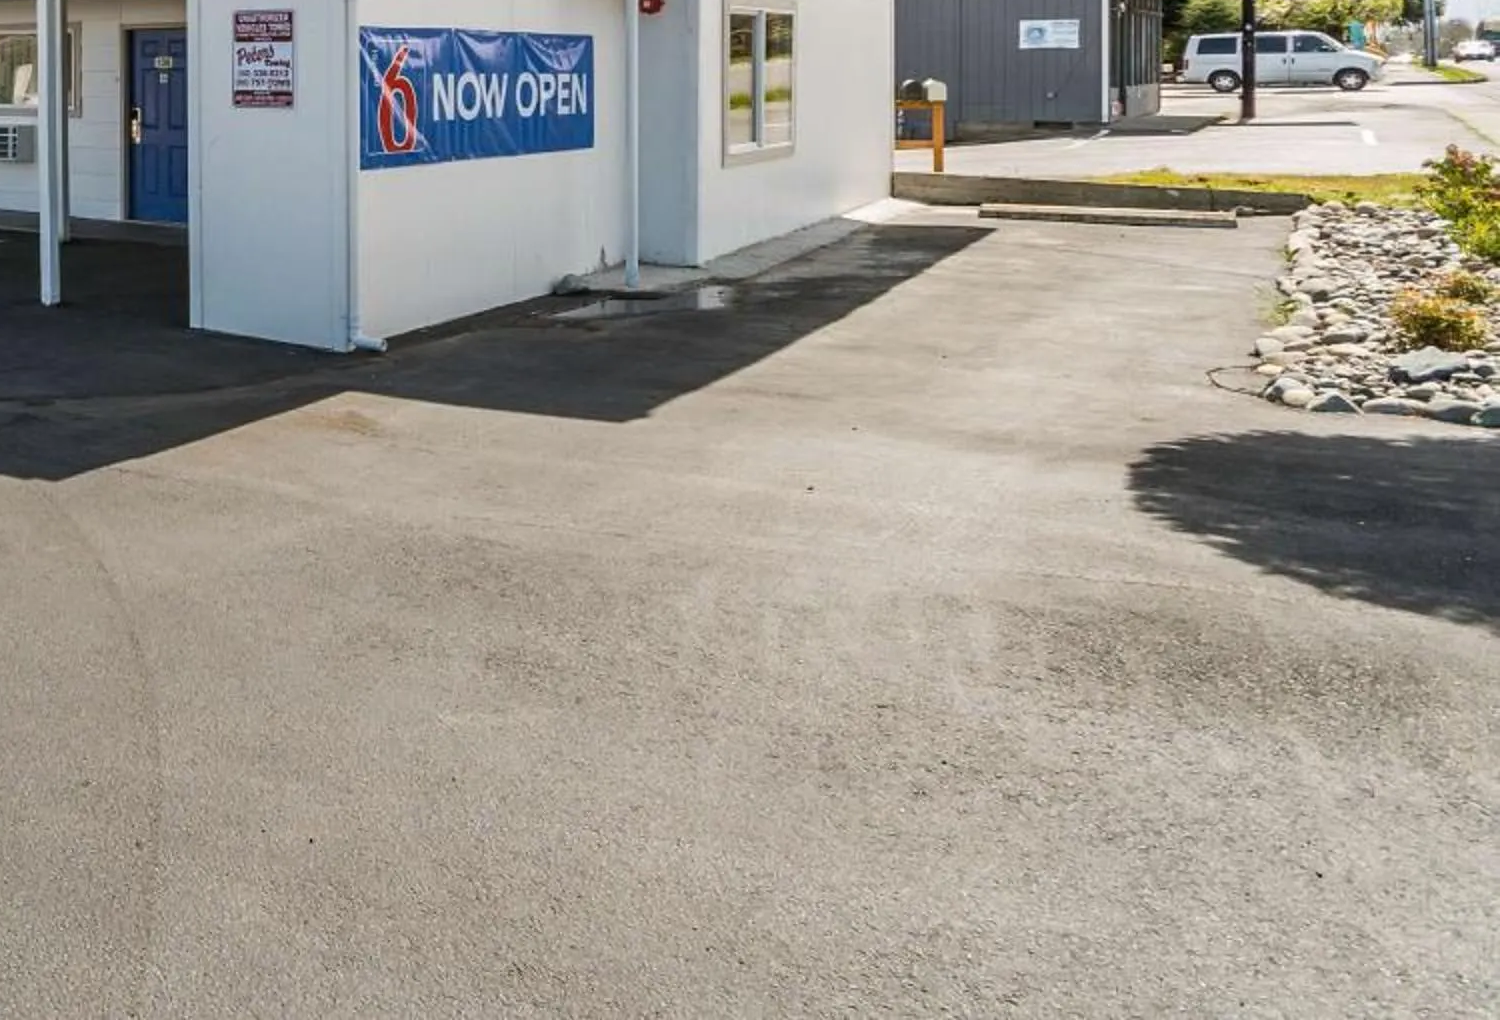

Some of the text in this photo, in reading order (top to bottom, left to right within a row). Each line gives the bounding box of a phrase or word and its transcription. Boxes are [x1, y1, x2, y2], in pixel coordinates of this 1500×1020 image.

[377, 43, 418, 154] 6
[432, 71, 588, 122] NOW OPEN
